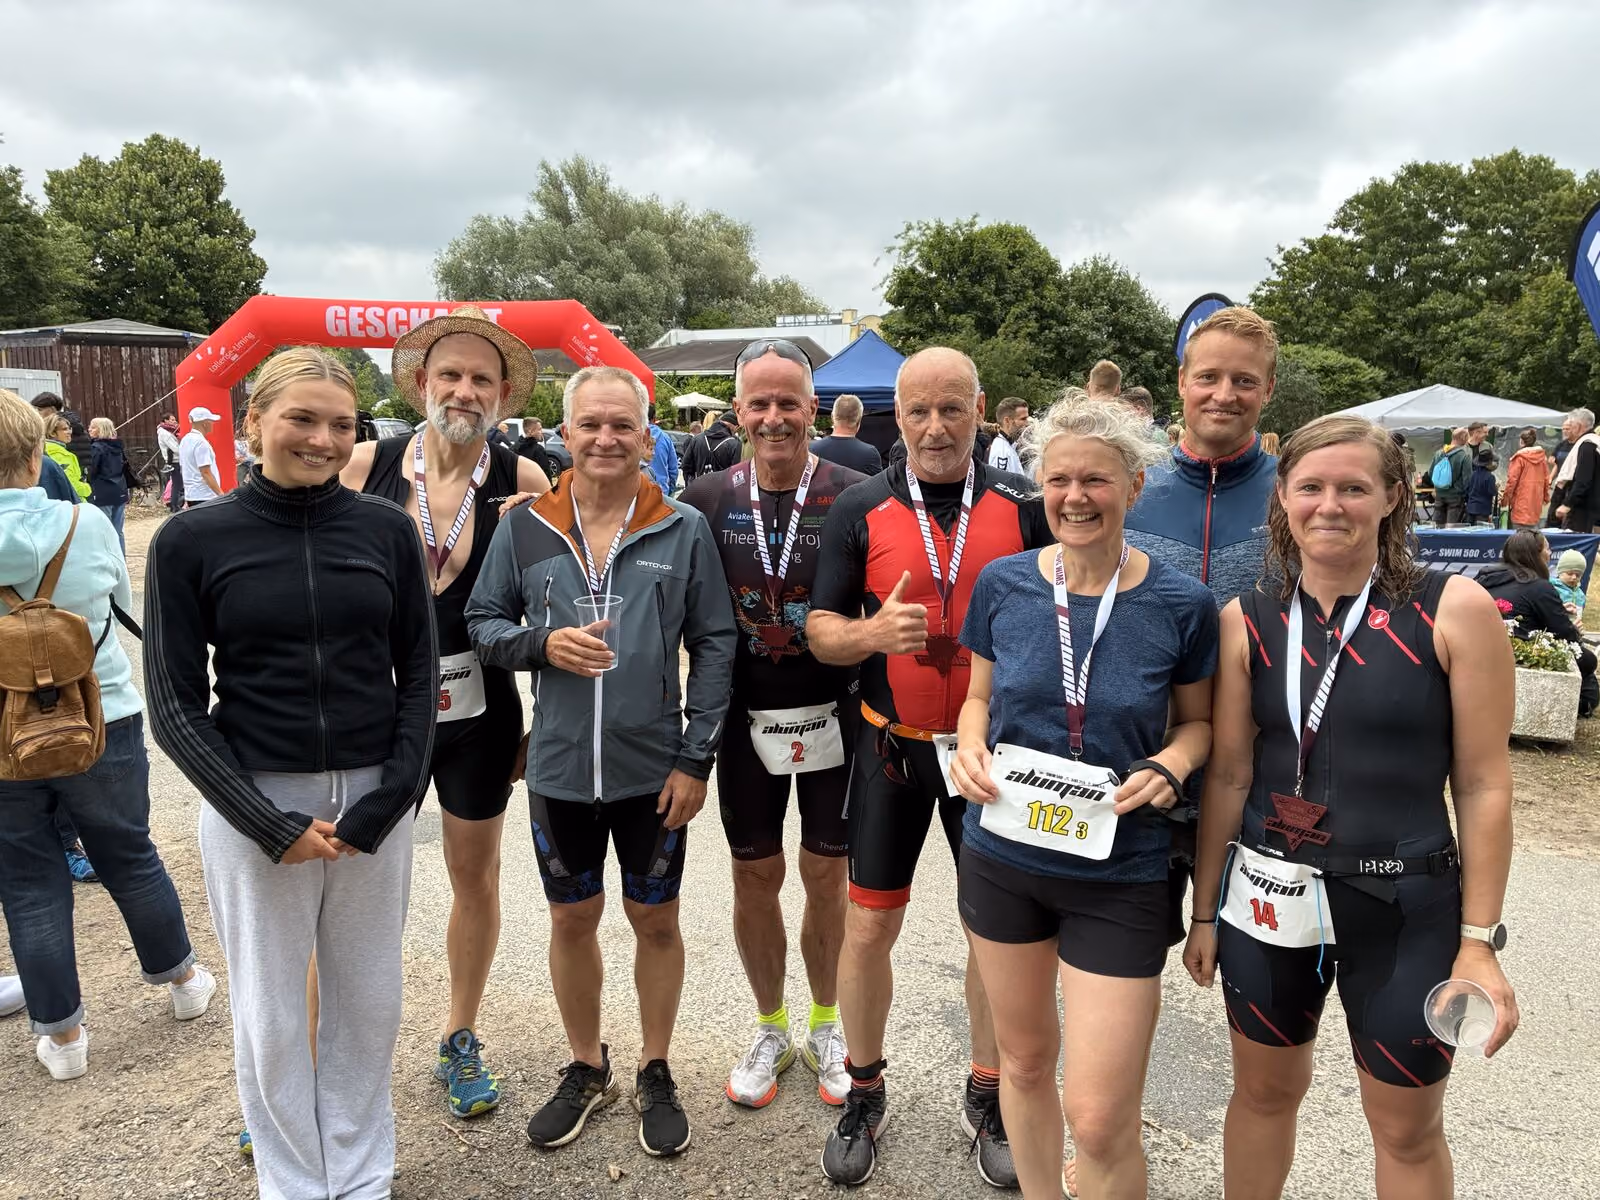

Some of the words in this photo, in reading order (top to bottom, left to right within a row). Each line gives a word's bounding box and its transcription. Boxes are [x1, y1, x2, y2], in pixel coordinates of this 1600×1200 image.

[800, 470, 810, 488] SWIM
[995, 482, 1025, 499] 2XU
[445, 486, 476, 551] aluman
[778, 508, 801, 580] aluman
[915, 508, 942, 580] aluman
[948, 510, 970, 585] aluman
[1439, 548, 1463, 558] SWIM
[1463, 548, 1480, 558] 500
[636, 559, 673, 571] ORTOVOX
[1055, 566, 1064, 586] SWIM
[1058, 614, 1078, 707] aluman
[761, 719, 828, 738] aluman
[791, 740, 805, 763] 2
[1004, 768, 1107, 802] aluman
[1027, 800, 1074, 837] 112
[1075, 821, 1089, 840] 3
[1250, 898, 1279, 932] 14
